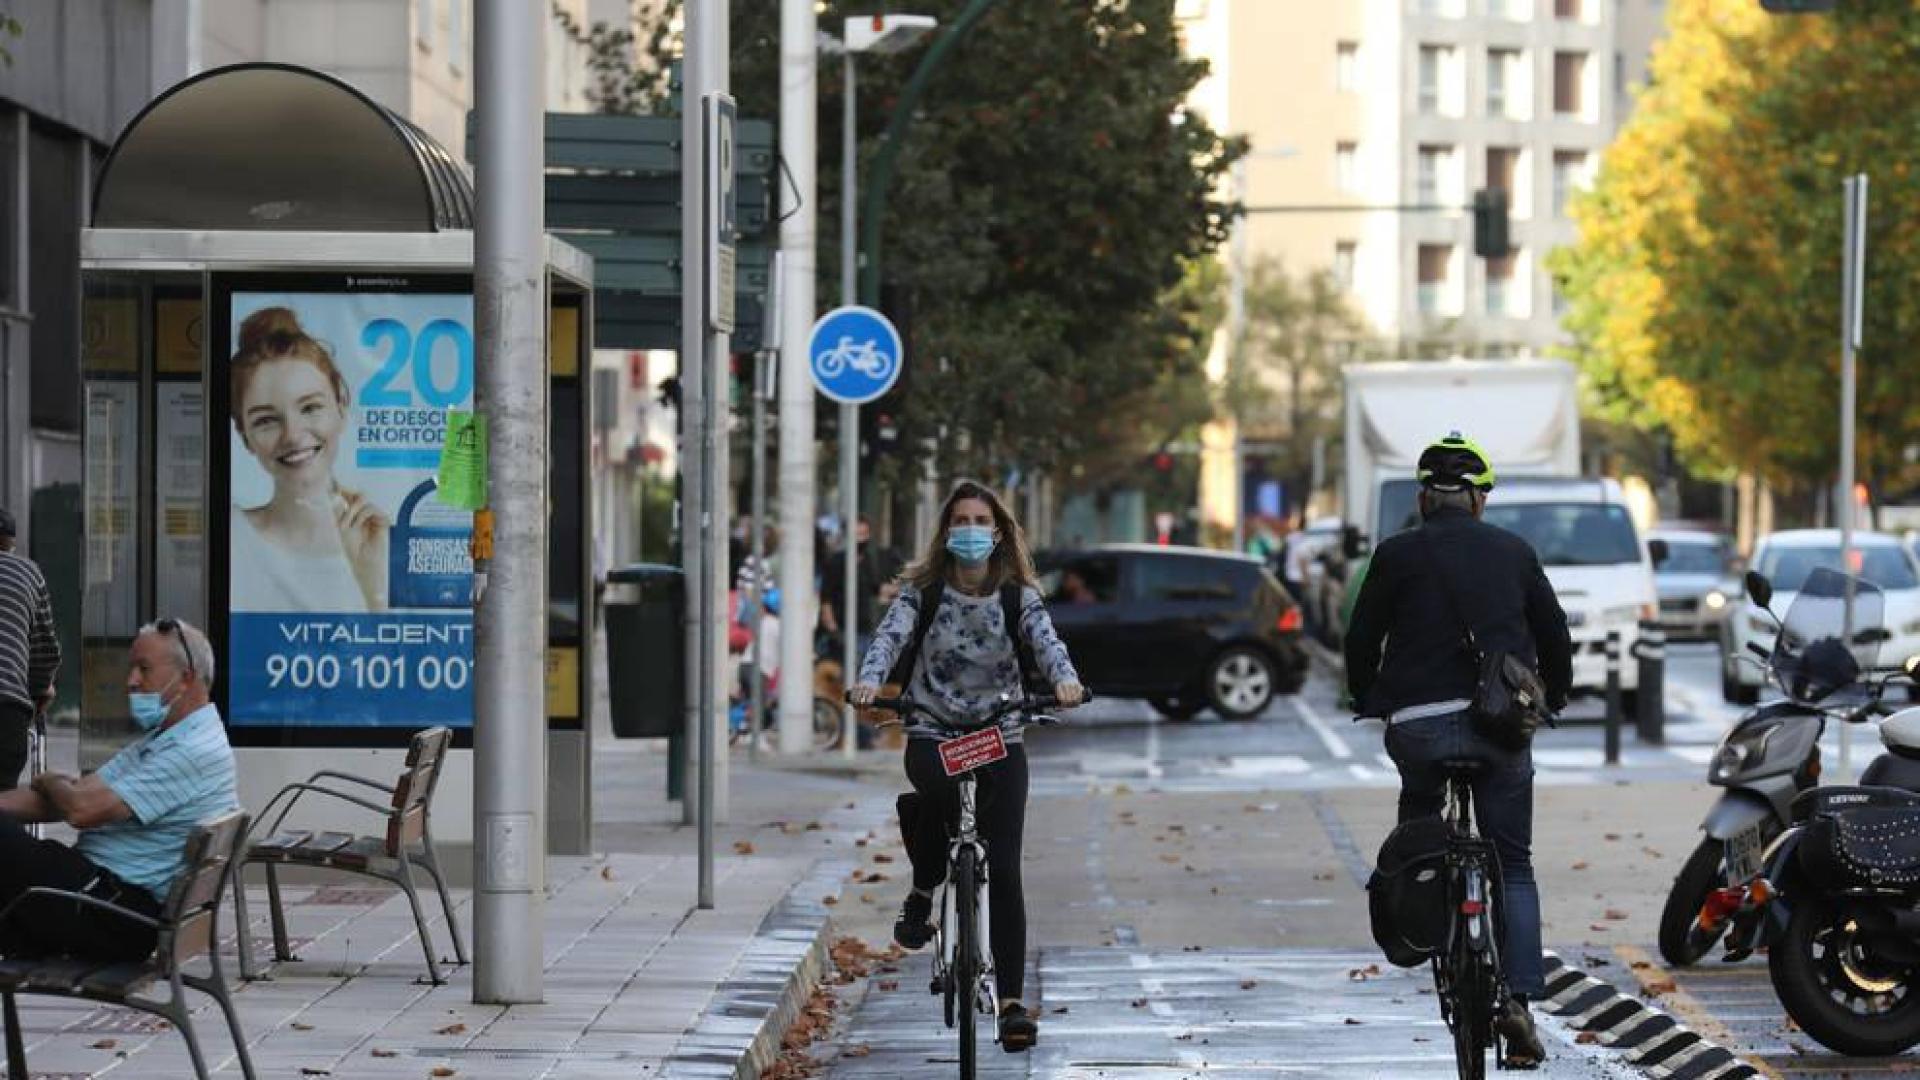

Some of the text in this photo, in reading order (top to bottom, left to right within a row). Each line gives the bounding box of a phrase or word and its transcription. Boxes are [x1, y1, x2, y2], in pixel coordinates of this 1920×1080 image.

[359, 317, 472, 407] 20
[366, 411, 447, 426] DE DESC
[358, 427, 380, 443] EN
[279, 623, 473, 643] VITALDENT
[265, 654, 474, 689] 900 101 00
